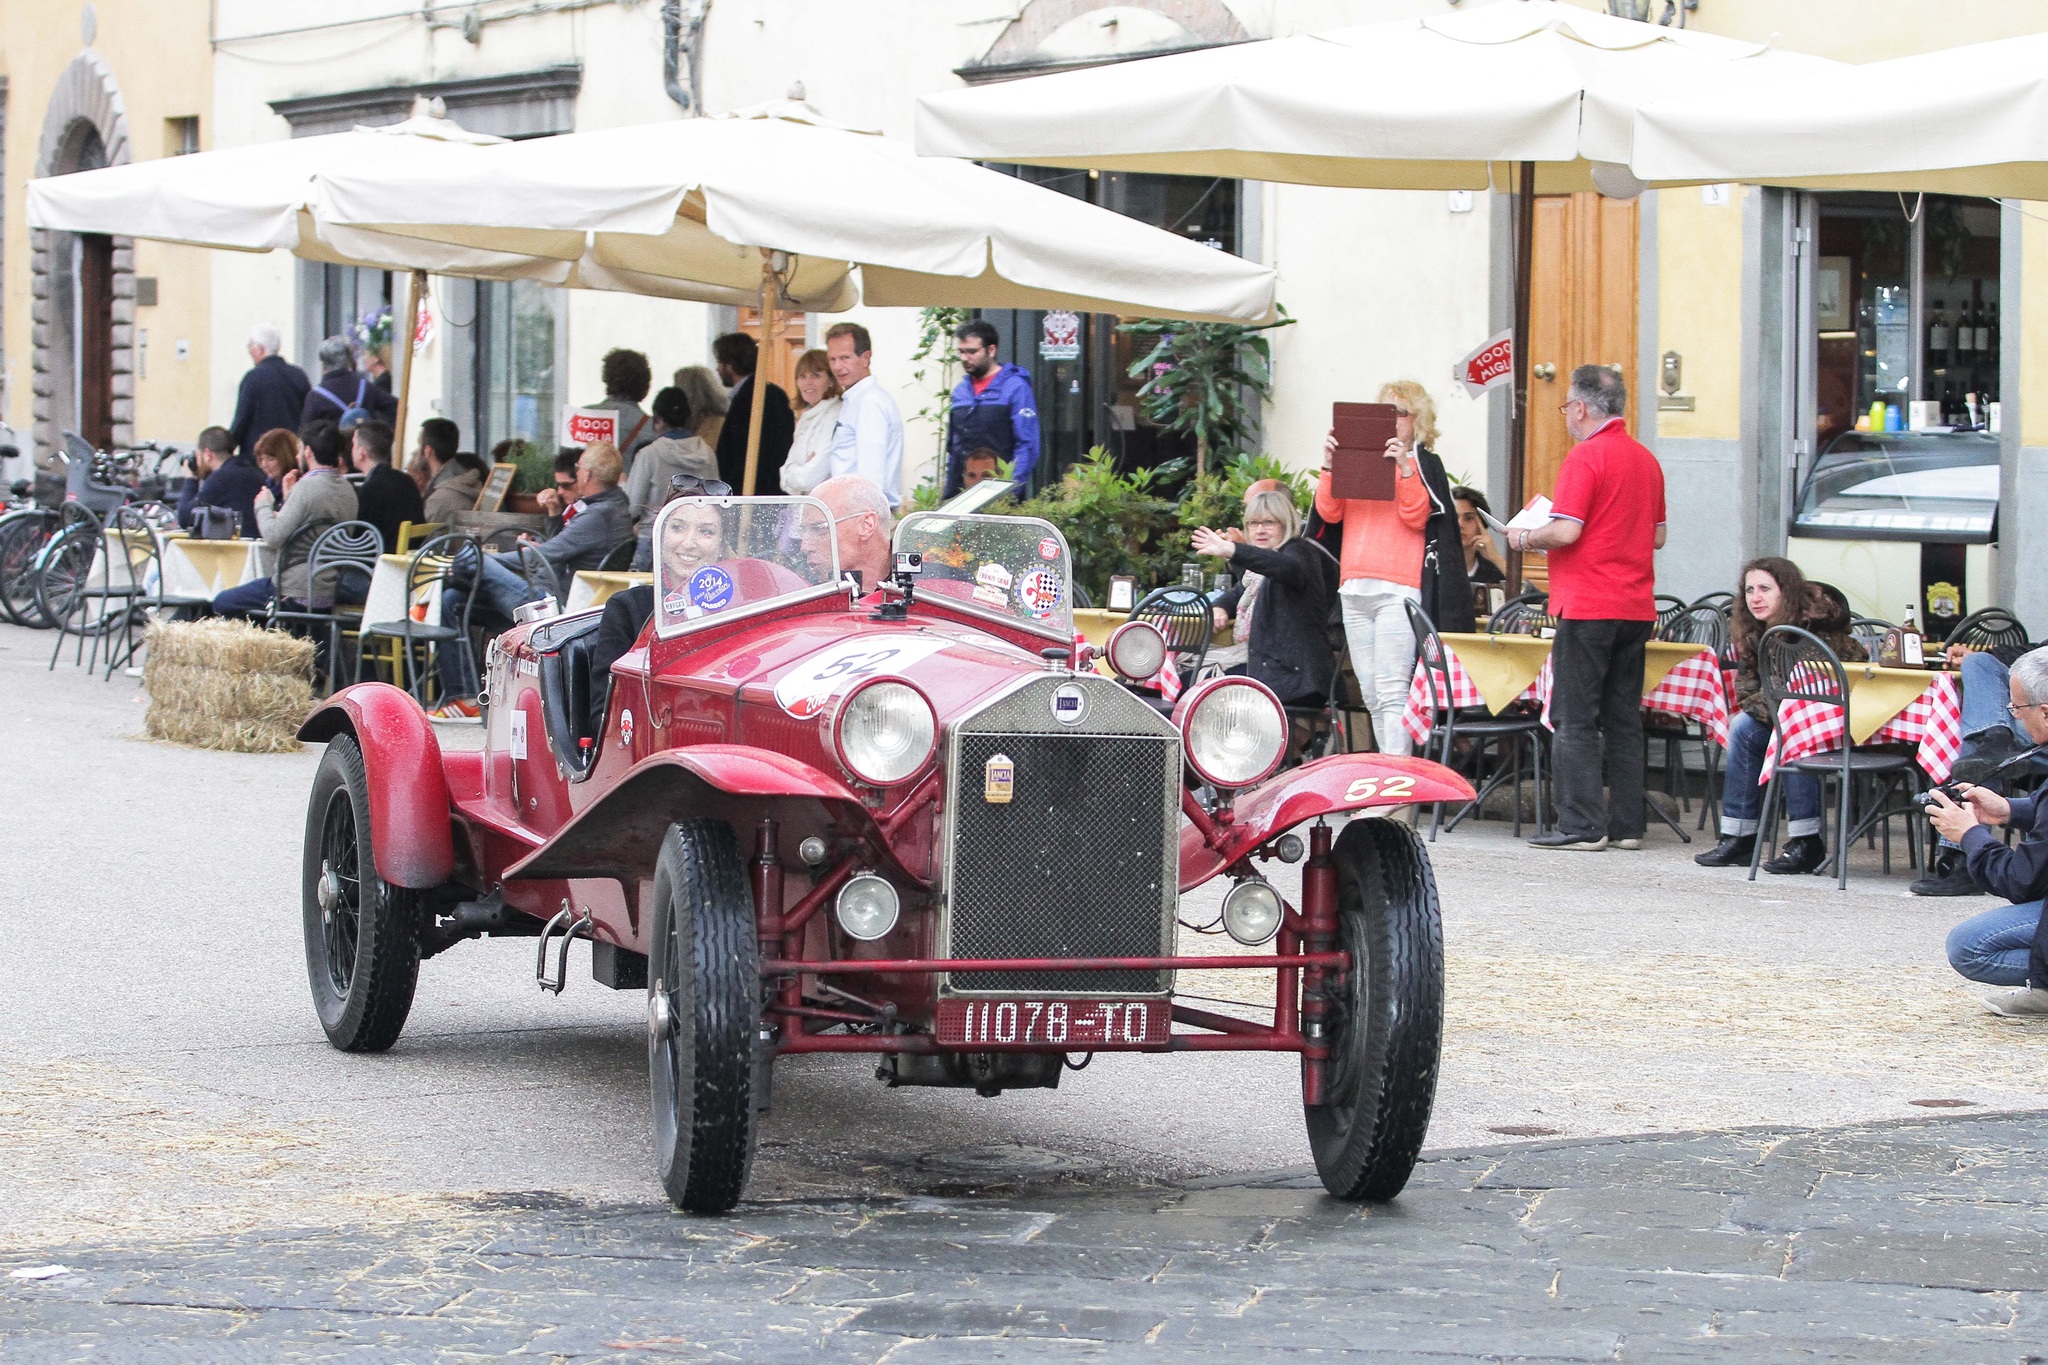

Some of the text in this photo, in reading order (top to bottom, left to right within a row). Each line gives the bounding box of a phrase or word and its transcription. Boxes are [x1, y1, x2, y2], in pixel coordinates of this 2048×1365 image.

[1480, 359, 1511, 381] MIGL
[577, 418, 611, 430] 1000
[698, 576, 723, 589] 2014
[700, 598, 727, 610] PASSED
[813, 649, 901, 680] 52
[991, 769, 1011, 781] LANCIA
[1343, 775, 1417, 802] 52
